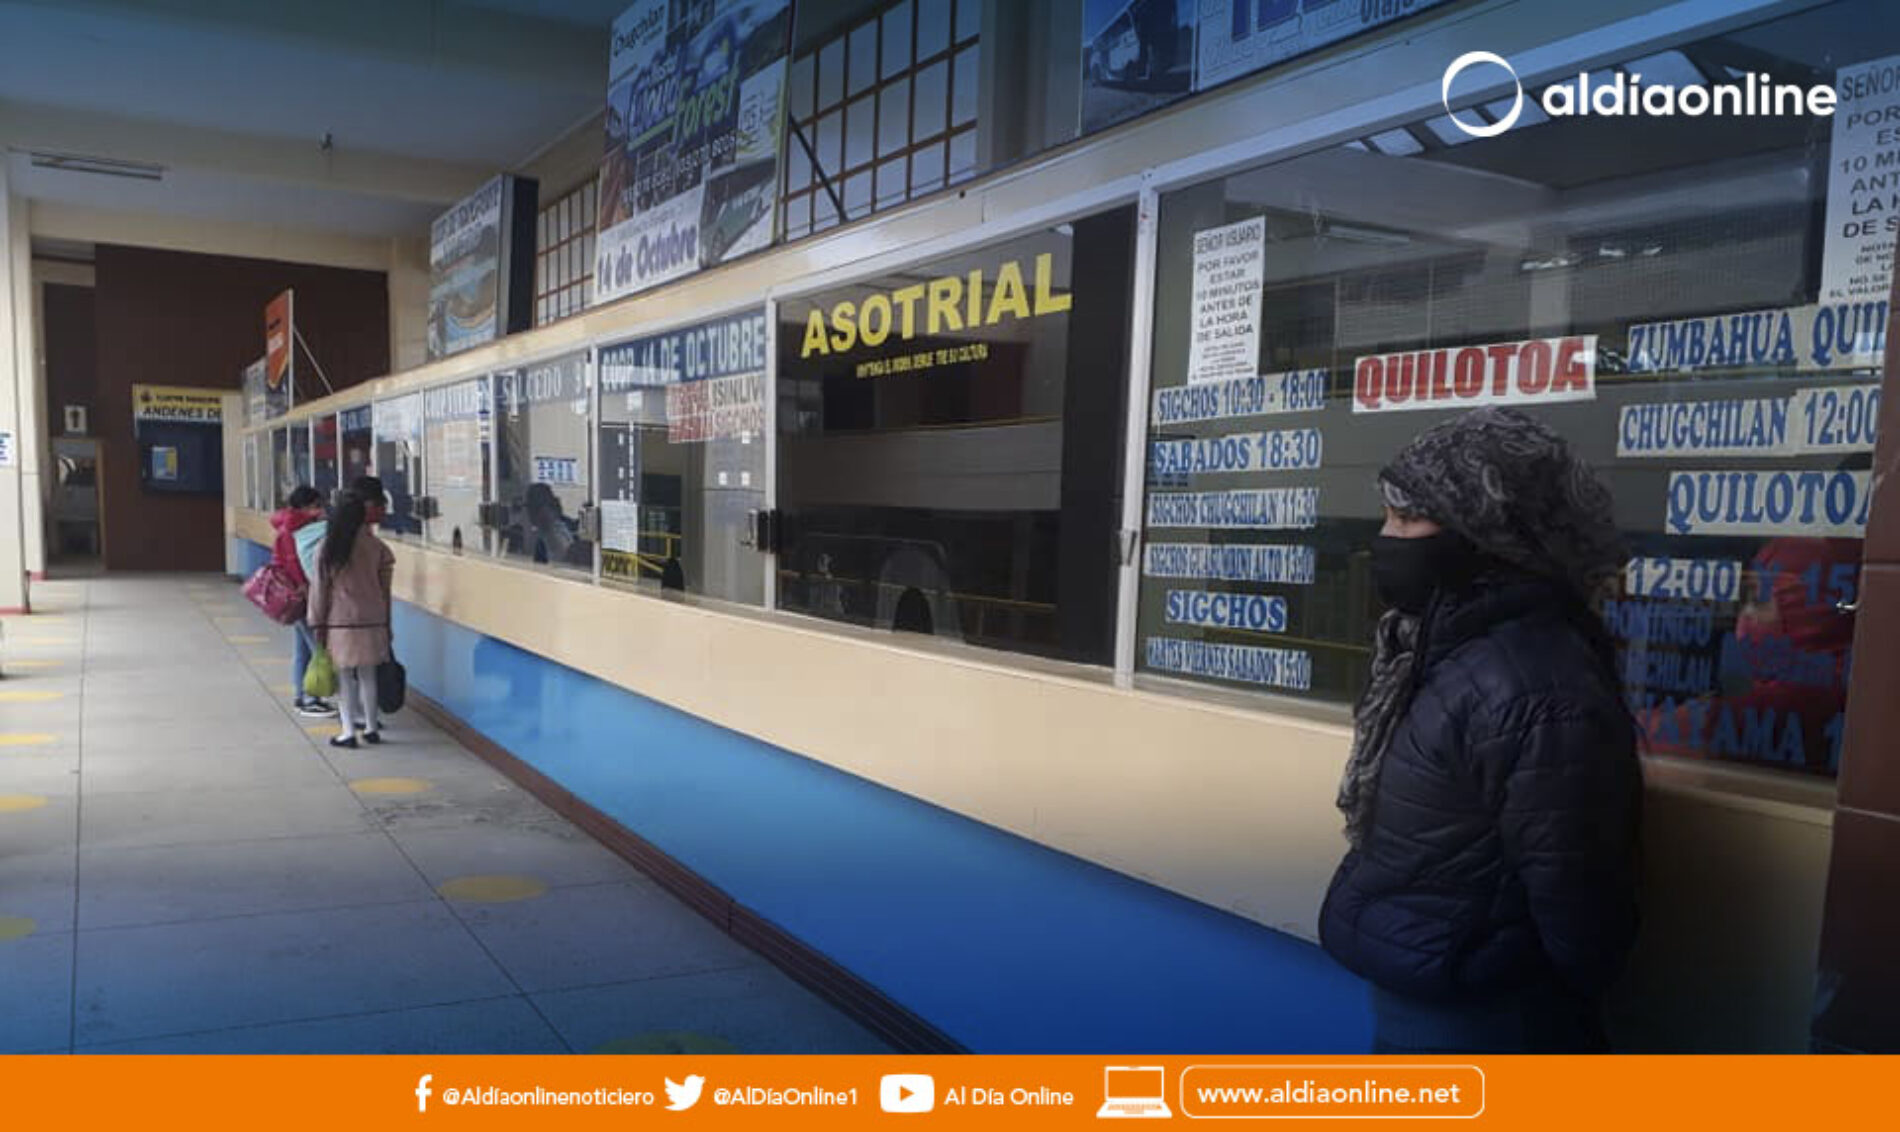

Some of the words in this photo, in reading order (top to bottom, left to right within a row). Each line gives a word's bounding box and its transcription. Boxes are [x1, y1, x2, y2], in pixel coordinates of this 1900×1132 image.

[1847, 106, 1900, 129] POR
[1842, 156, 1867, 174] 10
[1852, 196, 1884, 216] LA
[1843, 221, 1877, 238] DE
[616, 244, 632, 287] de
[637, 222, 696, 279] Octubre
[1197, 258, 1221, 273] POR
[1223, 250, 1260, 268] FAVOR
[1209, 281, 1260, 299] MINUTOS
[1210, 268, 1245, 285] ESTAR
[801, 253, 1072, 358] ASOTRIAL
[1201, 299, 1236, 314] ANTES
[1238, 294, 1253, 307] DE
[1197, 330, 1211, 342] DE
[1214, 323, 1253, 340] SALIDA
[1201, 315, 1213, 329] LA
[1216, 311, 1248, 325] HORA
[661, 335, 680, 382] DE
[686, 315, 765, 378] OCTUBRE
[1629, 312, 1794, 372] ZUMBAHUA
[1356, 337, 1588, 408] QUILOTOA
[1159, 384, 1218, 420] SIGCHOS
[1224, 378, 1265, 414] 10:30
[1280, 370, 1328, 410] 18:00
[1624, 396, 1789, 450] CHUGCHILAN
[1804, 387, 1882, 445] 12:00
[1257, 429, 1319, 468] 18:30
[1151, 494, 1198, 525] SIGCHOS
[1627, 555, 1736, 600] 12:00
[1168, 590, 1285, 631] SIGCHOS
